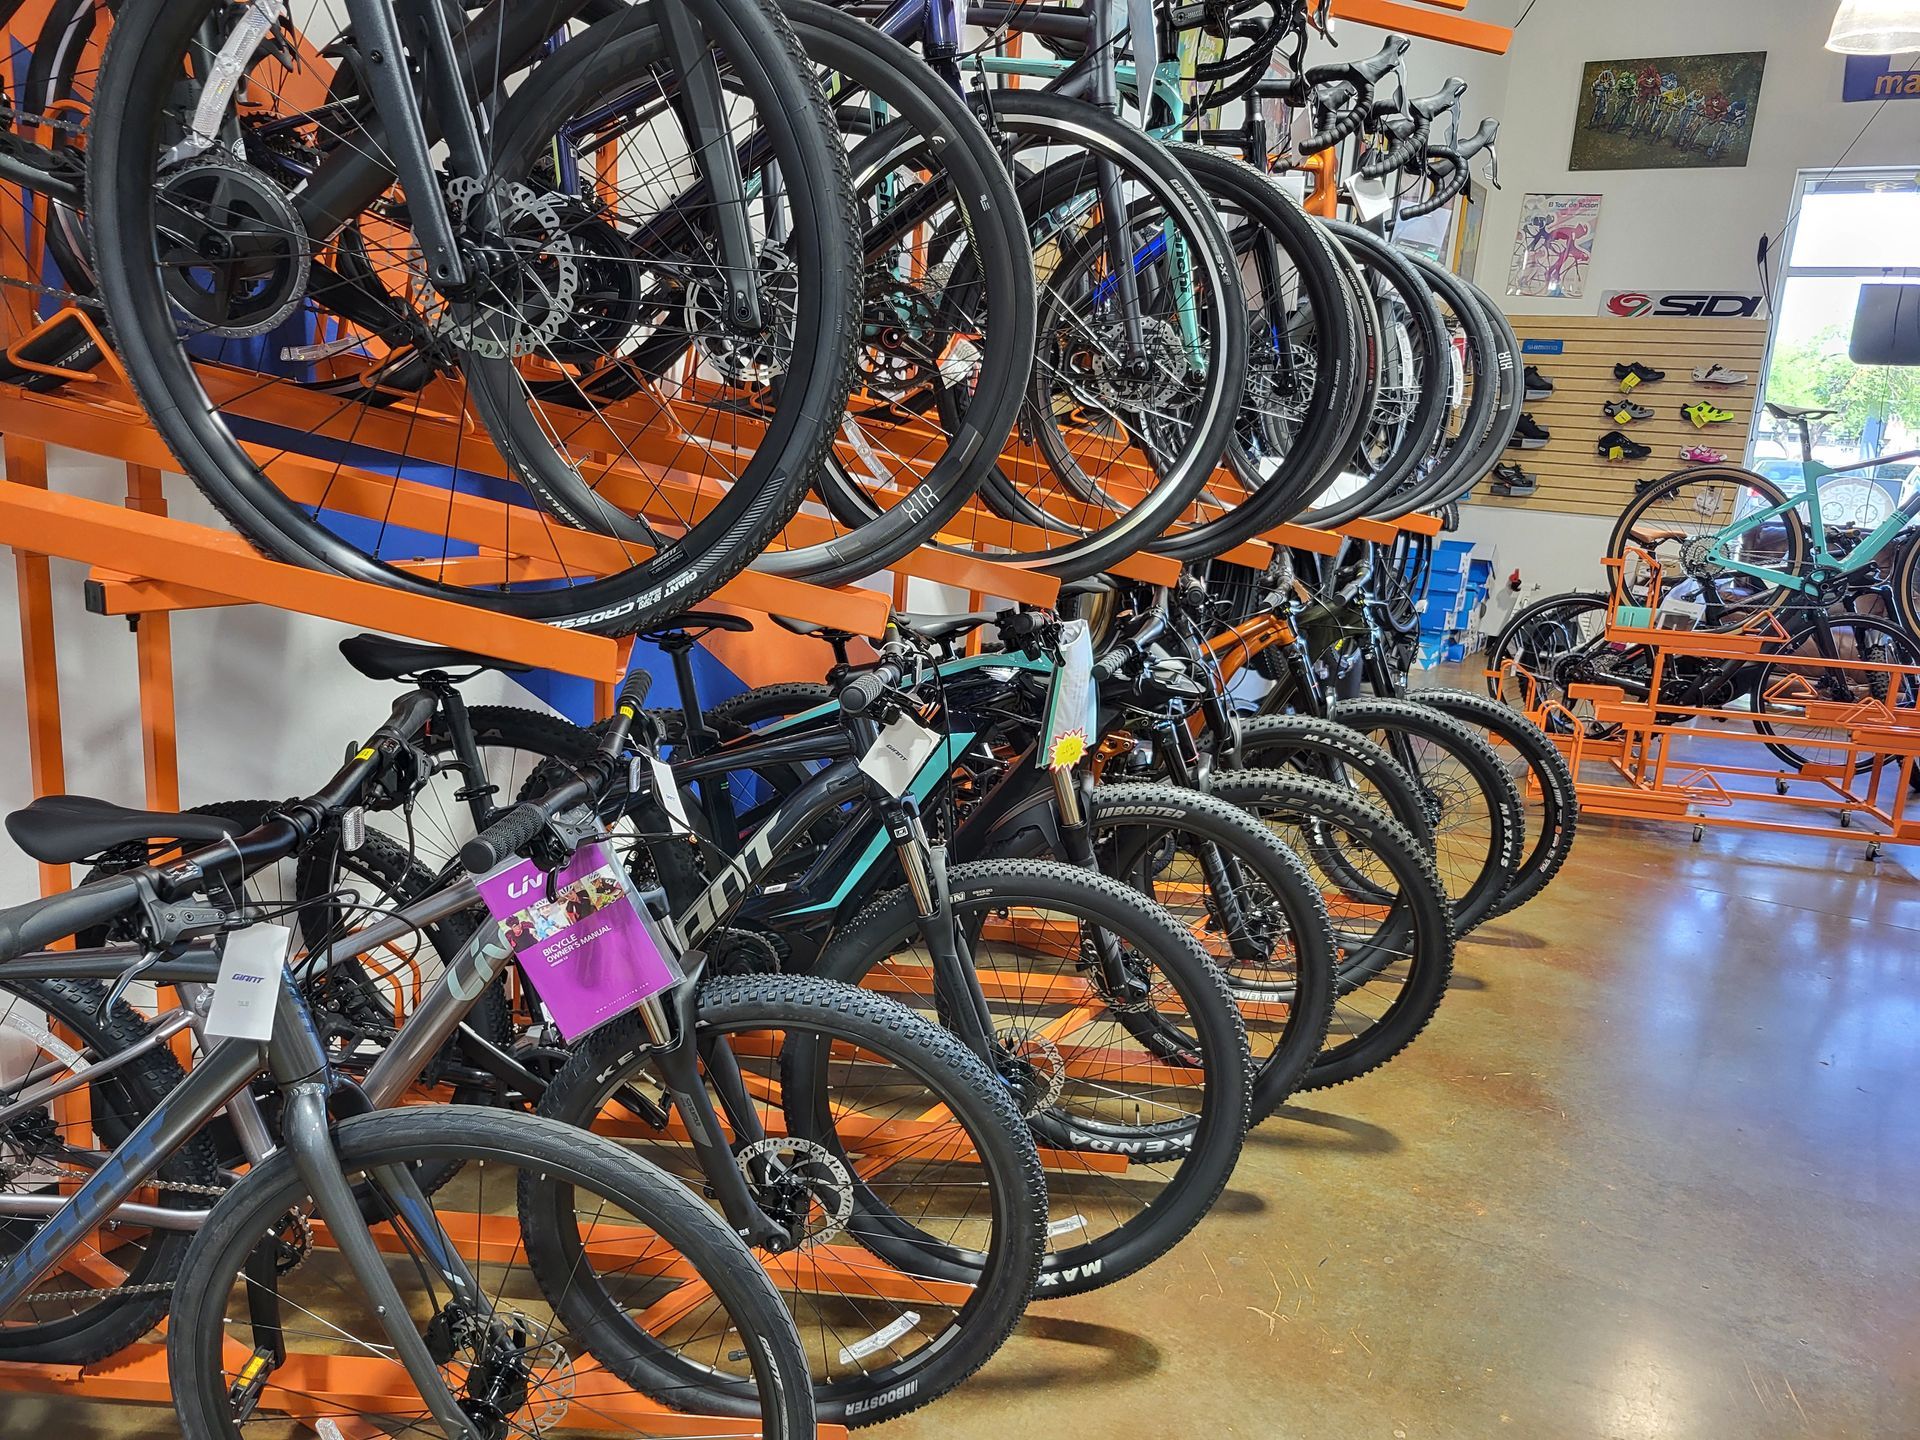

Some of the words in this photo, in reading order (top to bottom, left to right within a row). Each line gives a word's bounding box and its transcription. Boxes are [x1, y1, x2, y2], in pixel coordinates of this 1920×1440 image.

[1169, 179, 1200, 215] GIANT
[1653, 296, 1763, 316] SIDI
[539, 488, 587, 530] PIRELLI
[664, 570, 698, 598] GIANT
[886, 744, 908, 761] GIANT
[1302, 734, 1375, 766] MAXXIS
[1113, 806, 1187, 819] BOOSTER
[1260, 795, 1373, 839] KENDA
[1499, 802, 1513, 868] MAXXIS
[508, 872, 543, 898] Liv
[676, 810, 781, 949] ANT
[542, 933, 578, 957] BICYCLE
[546, 941, 581, 963] OWNER'S
[580, 925, 612, 945] MANUAL
[231, 973, 265, 984] GIANT
[1069, 1131, 1193, 1154] KENDA
[1040, 1258, 1102, 1287] MAX
[844, 1383, 906, 1416] BOOSTER
